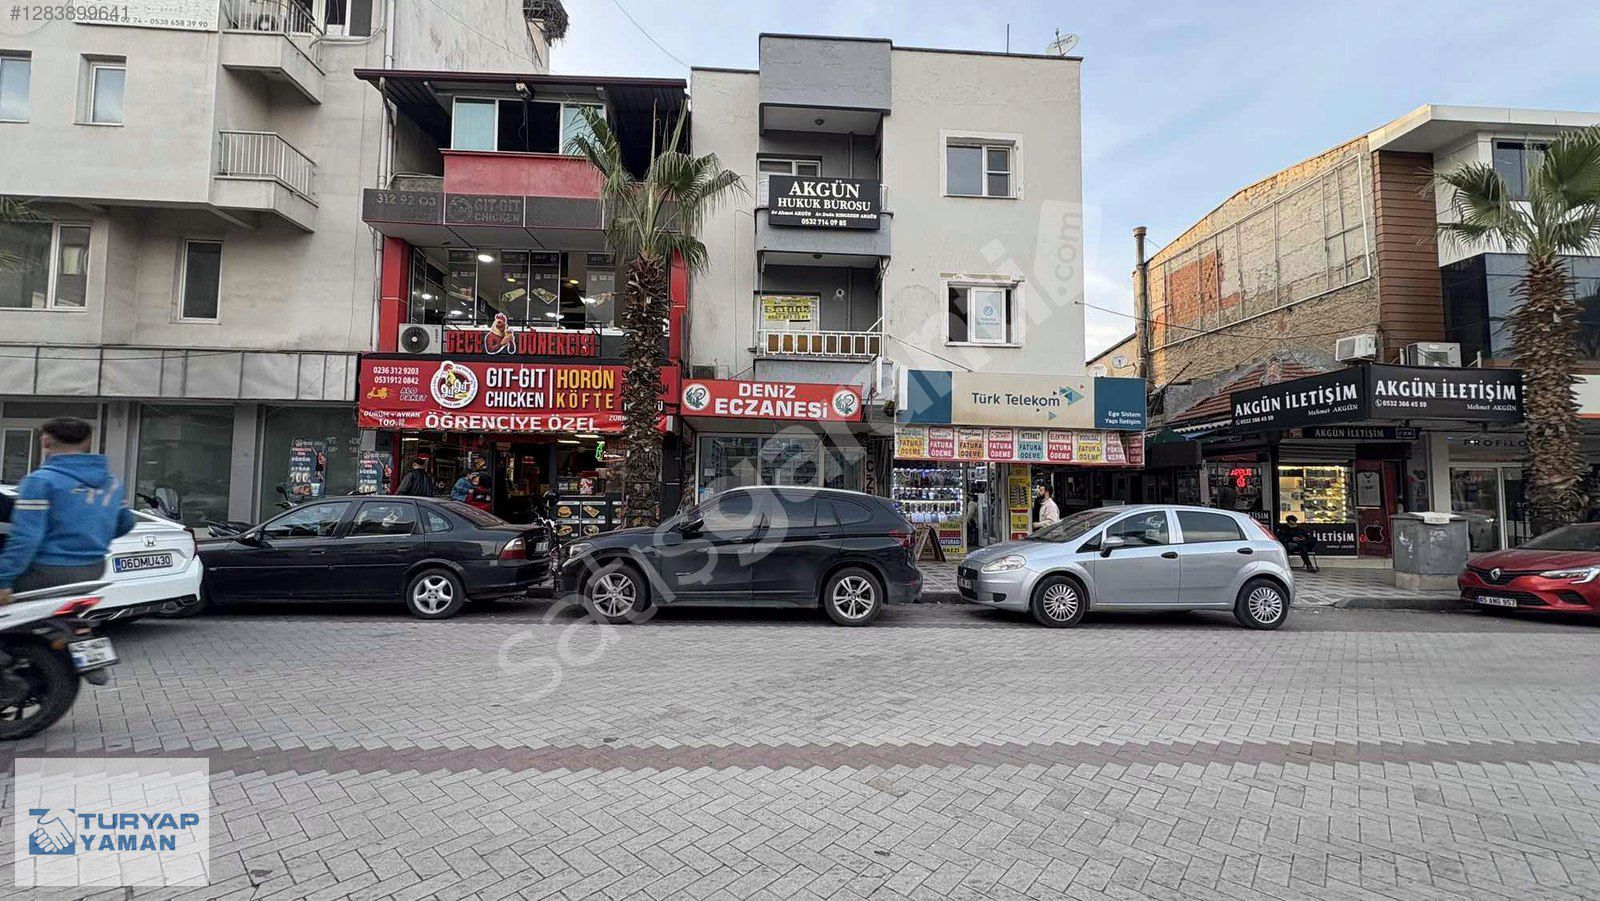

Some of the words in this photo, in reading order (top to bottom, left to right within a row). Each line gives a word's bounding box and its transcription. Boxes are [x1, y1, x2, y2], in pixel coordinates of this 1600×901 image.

[788, 180, 860, 199] AKGÜN
[376, 193, 396, 205] 312
[777, 197, 821, 209] HUKUK
[824, 199, 871, 212] BÜROSU
[445, 330, 482, 354] GECE
[373, 366, 389, 374] 0236
[391, 366, 402, 375] 312
[403, 367, 419, 375] 9203
[486, 367, 546, 389] GIT-GIT
[403, 377, 419, 385] 0842
[556, 369, 614, 390] HORON
[1375, 377, 1436, 397] AKGÜN
[1443, 378, 1516, 402] İLETİŞİM
[485, 391, 544, 409] CHICKEN
[556, 390, 614, 409] KÖFTE
[972, 392, 1000, 405] Türk
[1005, 393, 1060, 407] Telekom
[1235, 395, 1280, 417] AKGÜN
[1285, 382, 1358, 409] İLETİŞİM
[1467, 403, 1490, 411] Mehmet
[1308, 408, 1330, 416] Mehmet
[1332, 404, 1358, 413] AKGÜN
[425, 412, 541, 431] ÖĞRENCİYE
[548, 413, 598, 431] ÖZEL
[1315, 428, 1345, 438] AKGÜN
[1347, 427, 1384, 438] İLETİŞİM
[1049, 443, 1071, 451] FATURA
